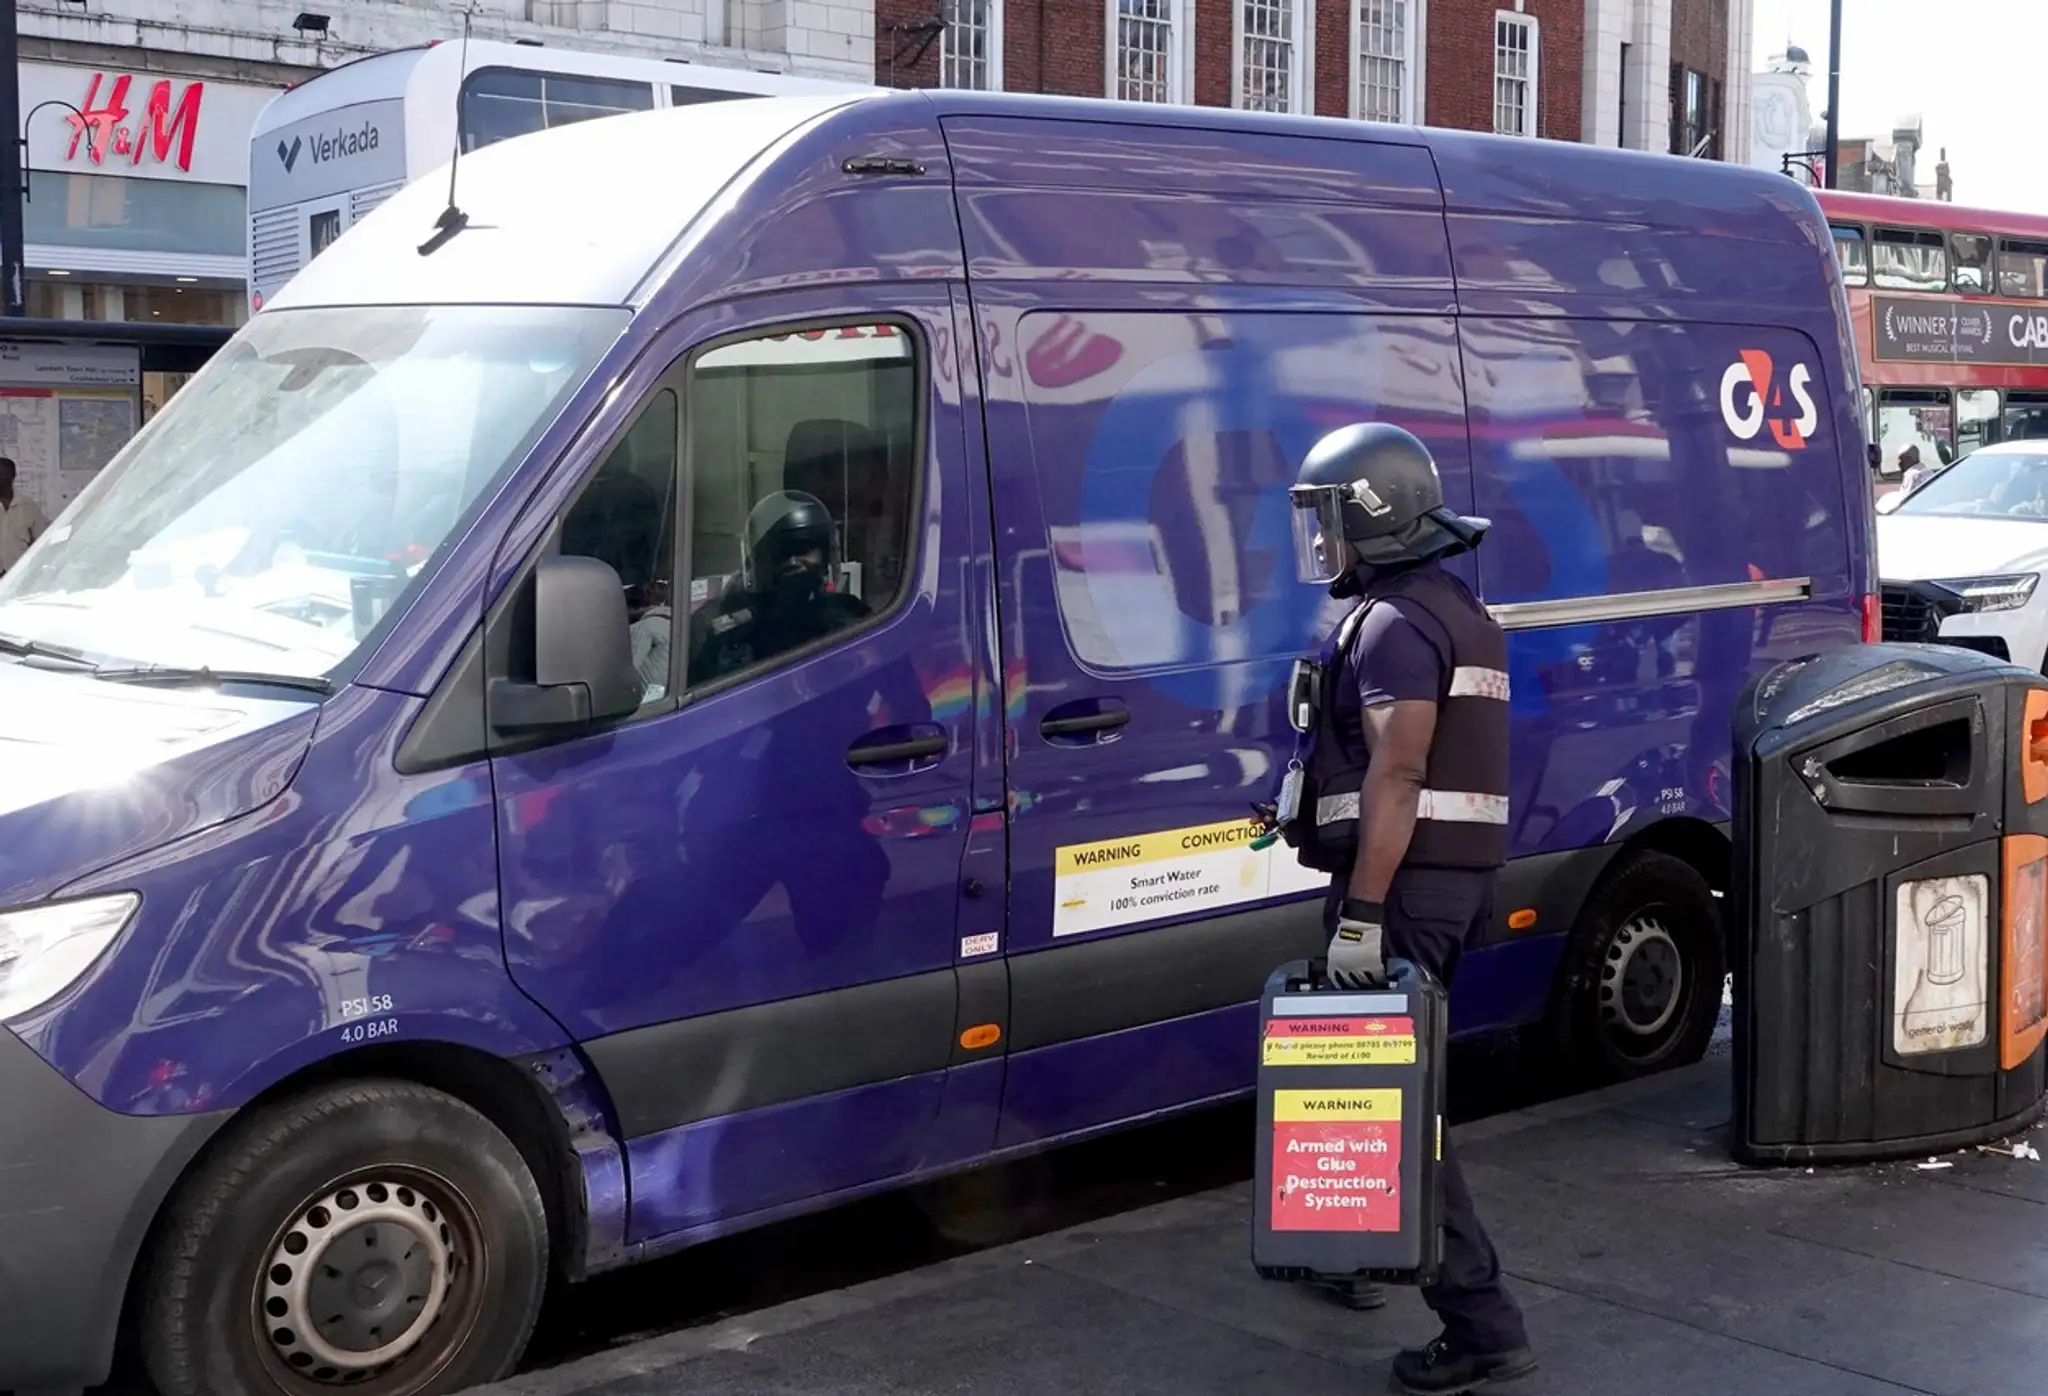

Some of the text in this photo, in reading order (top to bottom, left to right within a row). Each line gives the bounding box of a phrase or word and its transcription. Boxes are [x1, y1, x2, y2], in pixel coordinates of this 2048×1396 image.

[64, 72, 203, 172] H&M
[309, 121, 379, 164] Verkada
[1896, 315, 1958, 336] WINNER 7
[2008, 314, 2048, 348] CAB
[1906, 343, 1920, 352] BEST
[1921, 344, 1948, 354] MUSICAL
[1720, 348, 1817, 449] G4S
[1074, 844, 1141, 866] WARNING
[1130, 869, 1201, 890] Smart Water
[1110, 884, 1220, 911] 100% conviction rate
[341, 994, 393, 1017] PSI 58
[340, 1018, 398, 1043] 4.0 BAR
[1289, 1023, 1350, 1033] WARNING
[1908, 1024, 1946, 1039] general
[1301, 1041, 1326, 1052] please
[1328, 1041, 1354, 1050] phone
[1306, 1052, 1338, 1060] Reward
[1340, 1052, 1349, 1060] of
[1303, 1099, 1373, 1111] WARNING
[1286, 1139, 1388, 1153] Armed with
[1317, 1157, 1356, 1171] Glue
[1286, 1175, 1387, 1190] Destruction
[1304, 1193, 1368, 1211] System
